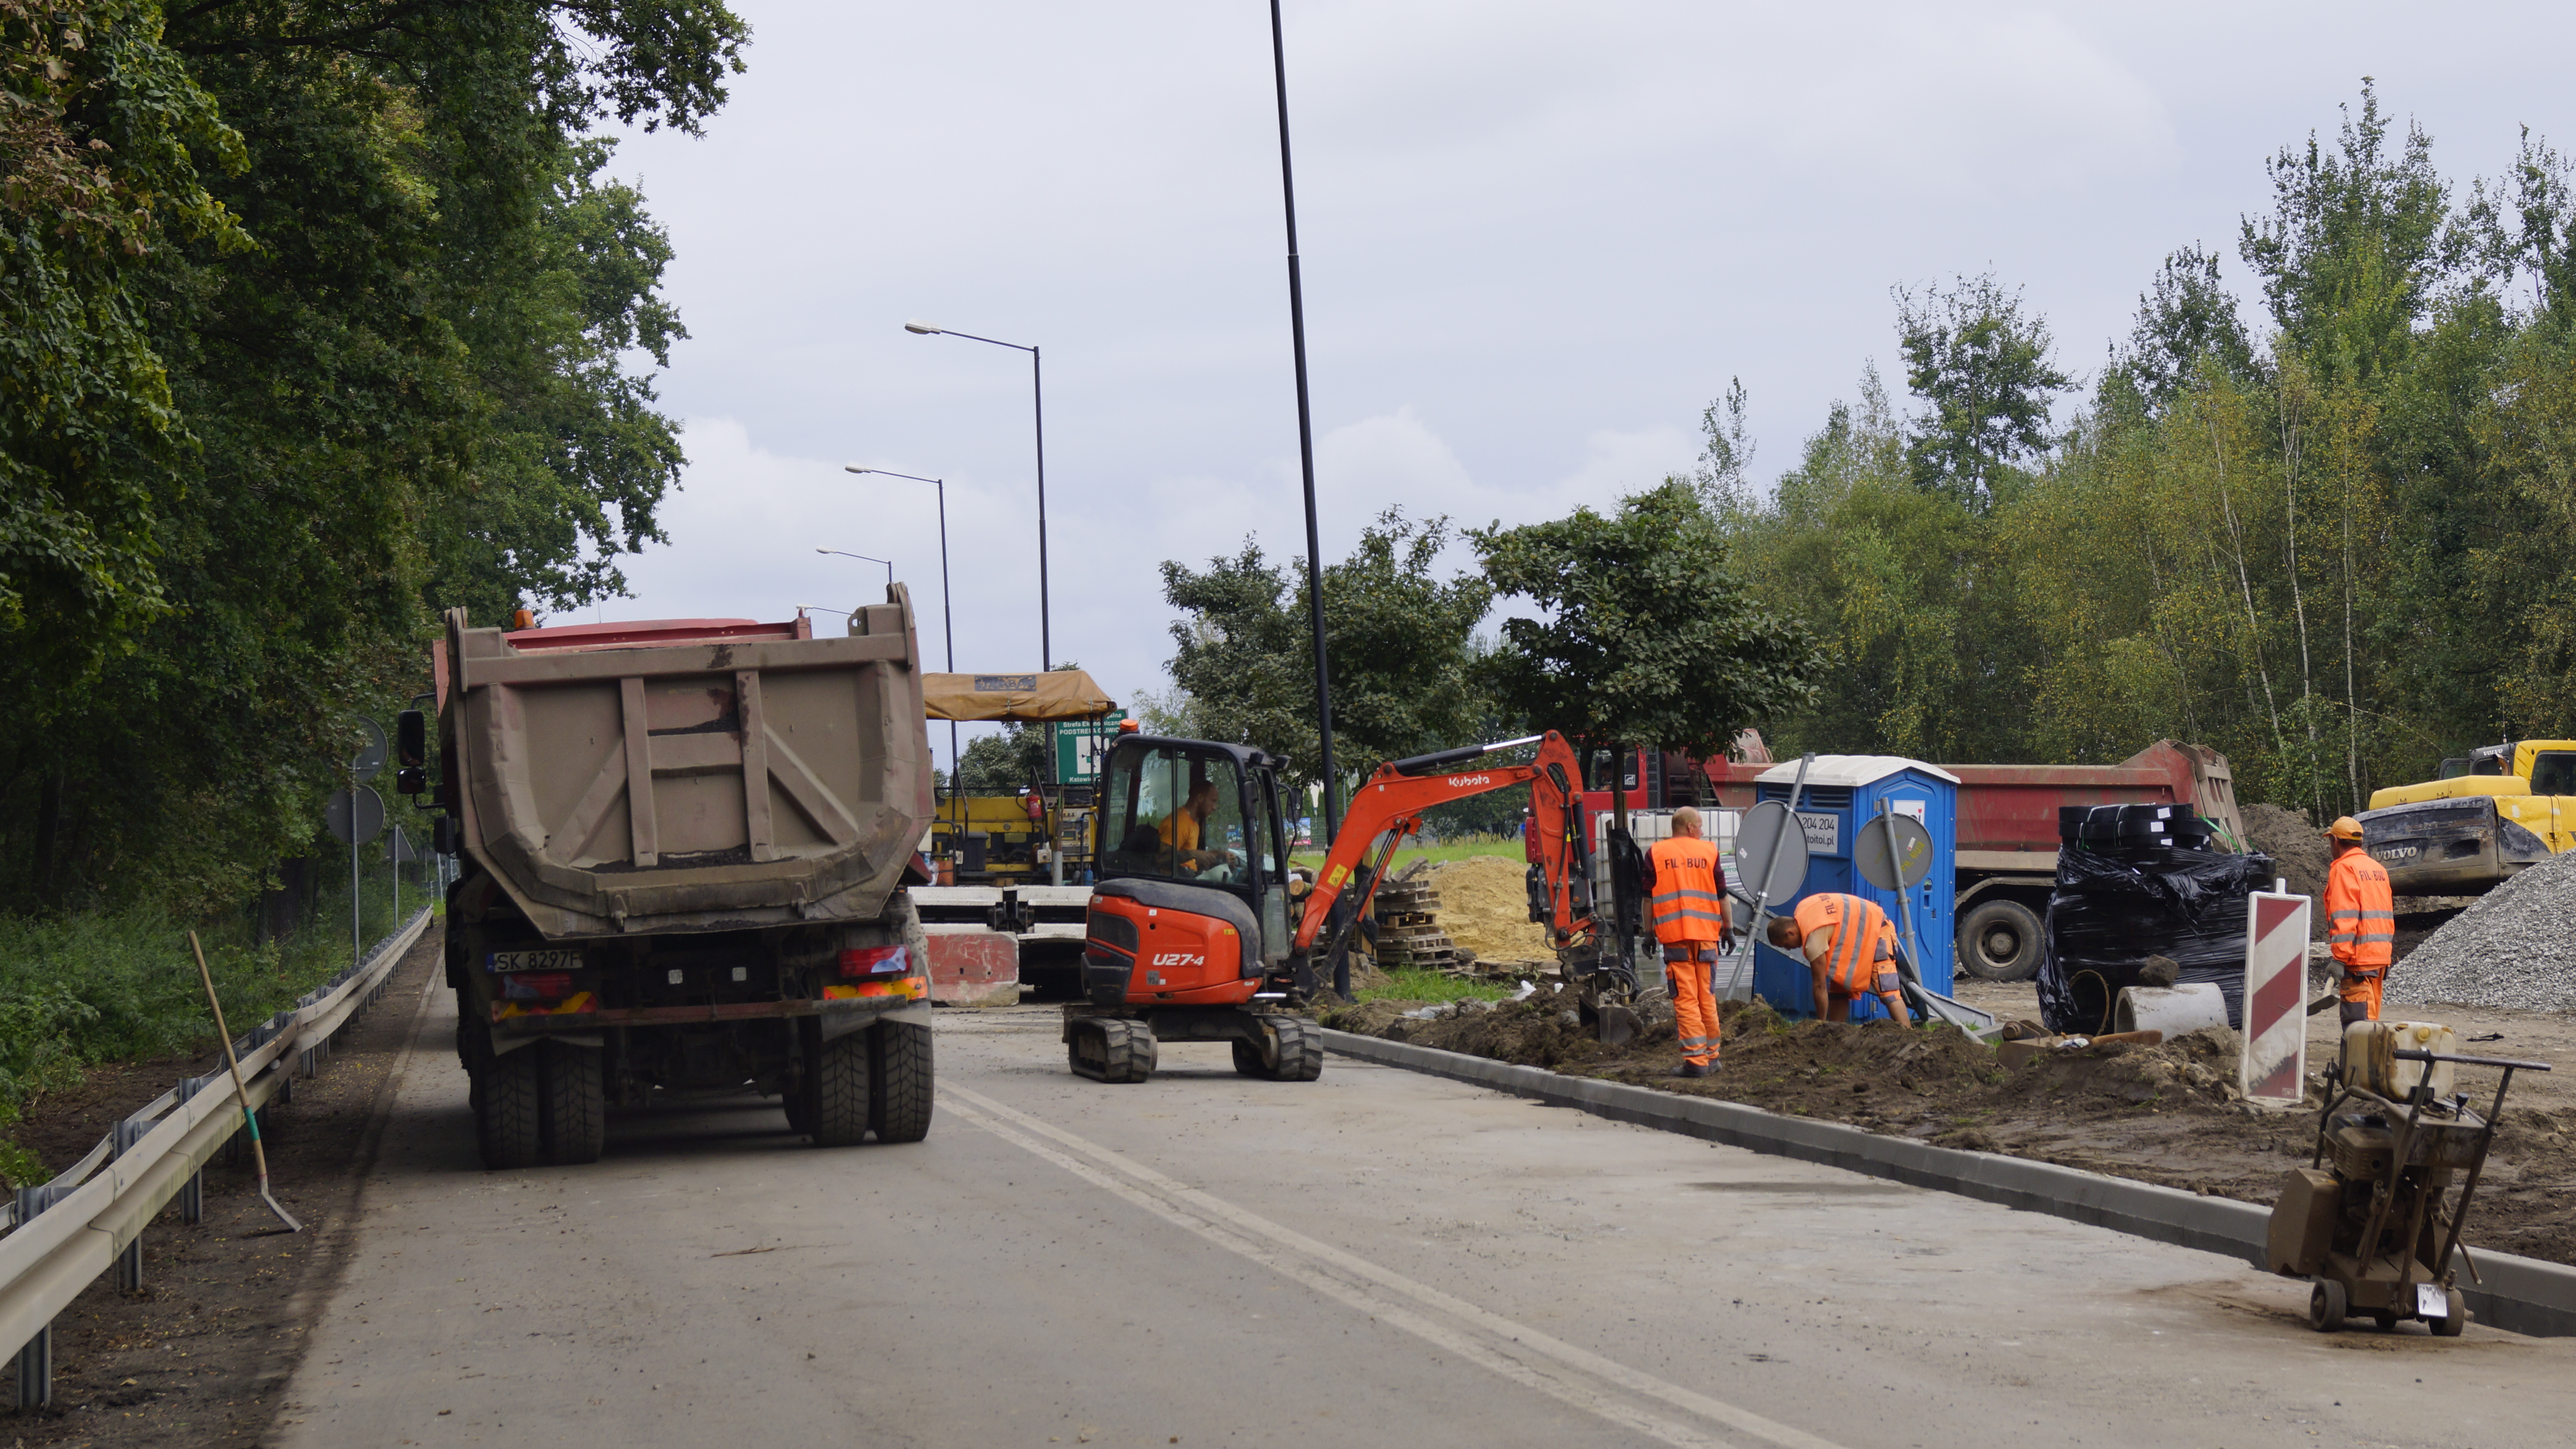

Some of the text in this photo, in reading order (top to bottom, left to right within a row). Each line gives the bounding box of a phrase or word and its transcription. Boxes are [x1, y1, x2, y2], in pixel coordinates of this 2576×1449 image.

[1449, 774, 1490, 787] Kubota
[1802, 817, 1835, 830] 204 204
[1807, 834, 1835, 847] toitoi.pl
[2375, 846, 2417, 862] VOLVO
[1665, 858, 1679, 870] FIL
[1686, 858, 1707, 869] BUD
[498, 950, 580, 970] SK 8297F
[1152, 953, 1205, 966] U27-4
